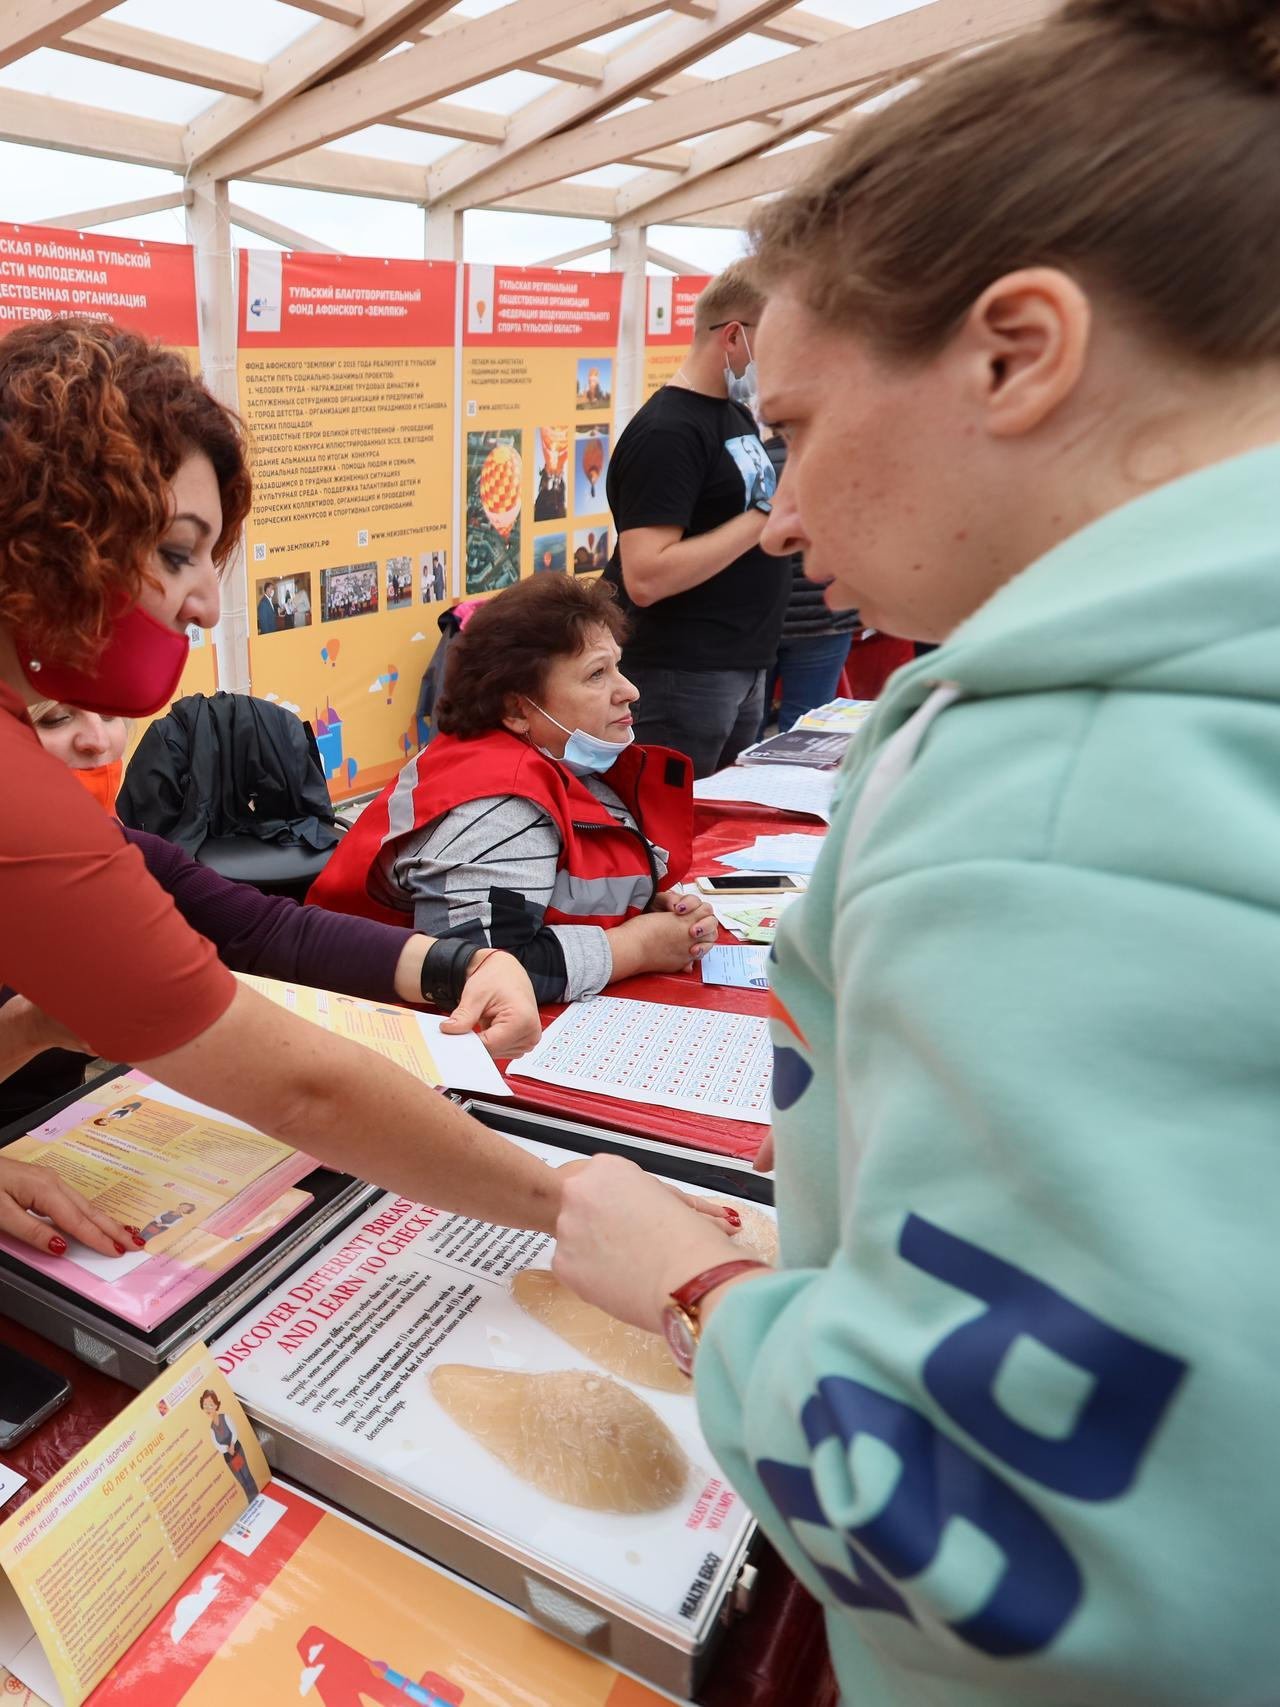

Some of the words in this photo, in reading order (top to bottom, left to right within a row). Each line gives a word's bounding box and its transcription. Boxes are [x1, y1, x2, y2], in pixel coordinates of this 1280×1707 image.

[34, 241, 95, 263] РАЙОННАЯ
[96, 250, 151, 268] ТУЛЬСКОЙ
[27, 264, 107, 284] МОЛОДЕЖНАЯ
[71, 289, 147, 308] ОРГАНИЗАЦИЯ
[288, 285, 334, 299] ТУЛЬСКИЙ
[334, 288, 421, 302] БЛАГОТВОРИТЕЛЬНЫЙ
[288, 303, 314, 316] ФОНД
[314, 303, 364, 316] АФОНСКОГО
[364, 305, 408, 316] «ЗЕМЛЯКИ»
[276, 1319, 318, 1354] AND
[305, 1274, 367, 1321] LEARN
[355, 1256, 387, 1275] TO
[376, 1213, 432, 1256] CHECK
[214, 1302, 299, 1375] DISCOVER
[287, 1233, 373, 1310] DIFFERENT
